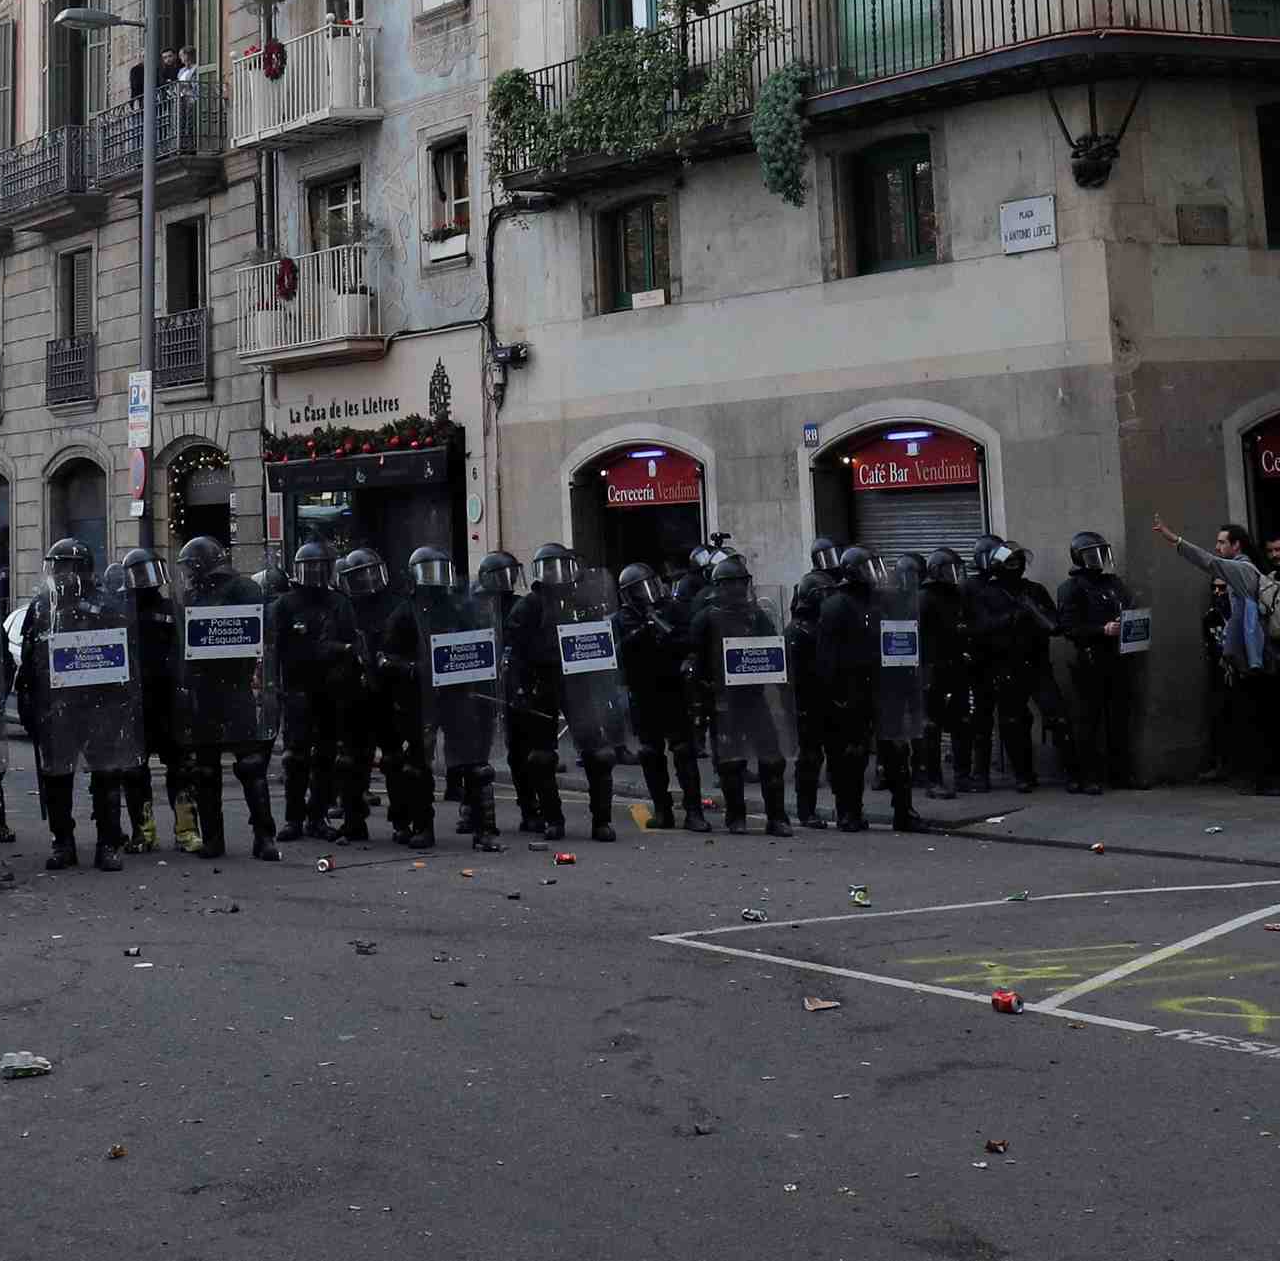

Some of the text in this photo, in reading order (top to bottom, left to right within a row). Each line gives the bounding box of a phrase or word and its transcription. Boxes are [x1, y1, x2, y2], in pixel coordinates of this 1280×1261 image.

[289, 396, 399, 424] La Casa de les Lletres
[859, 457, 972, 485] Café Bar Vendimia
[607, 481, 697, 502] Cervecería Vendimi
[208, 627, 244, 636] Mossos
